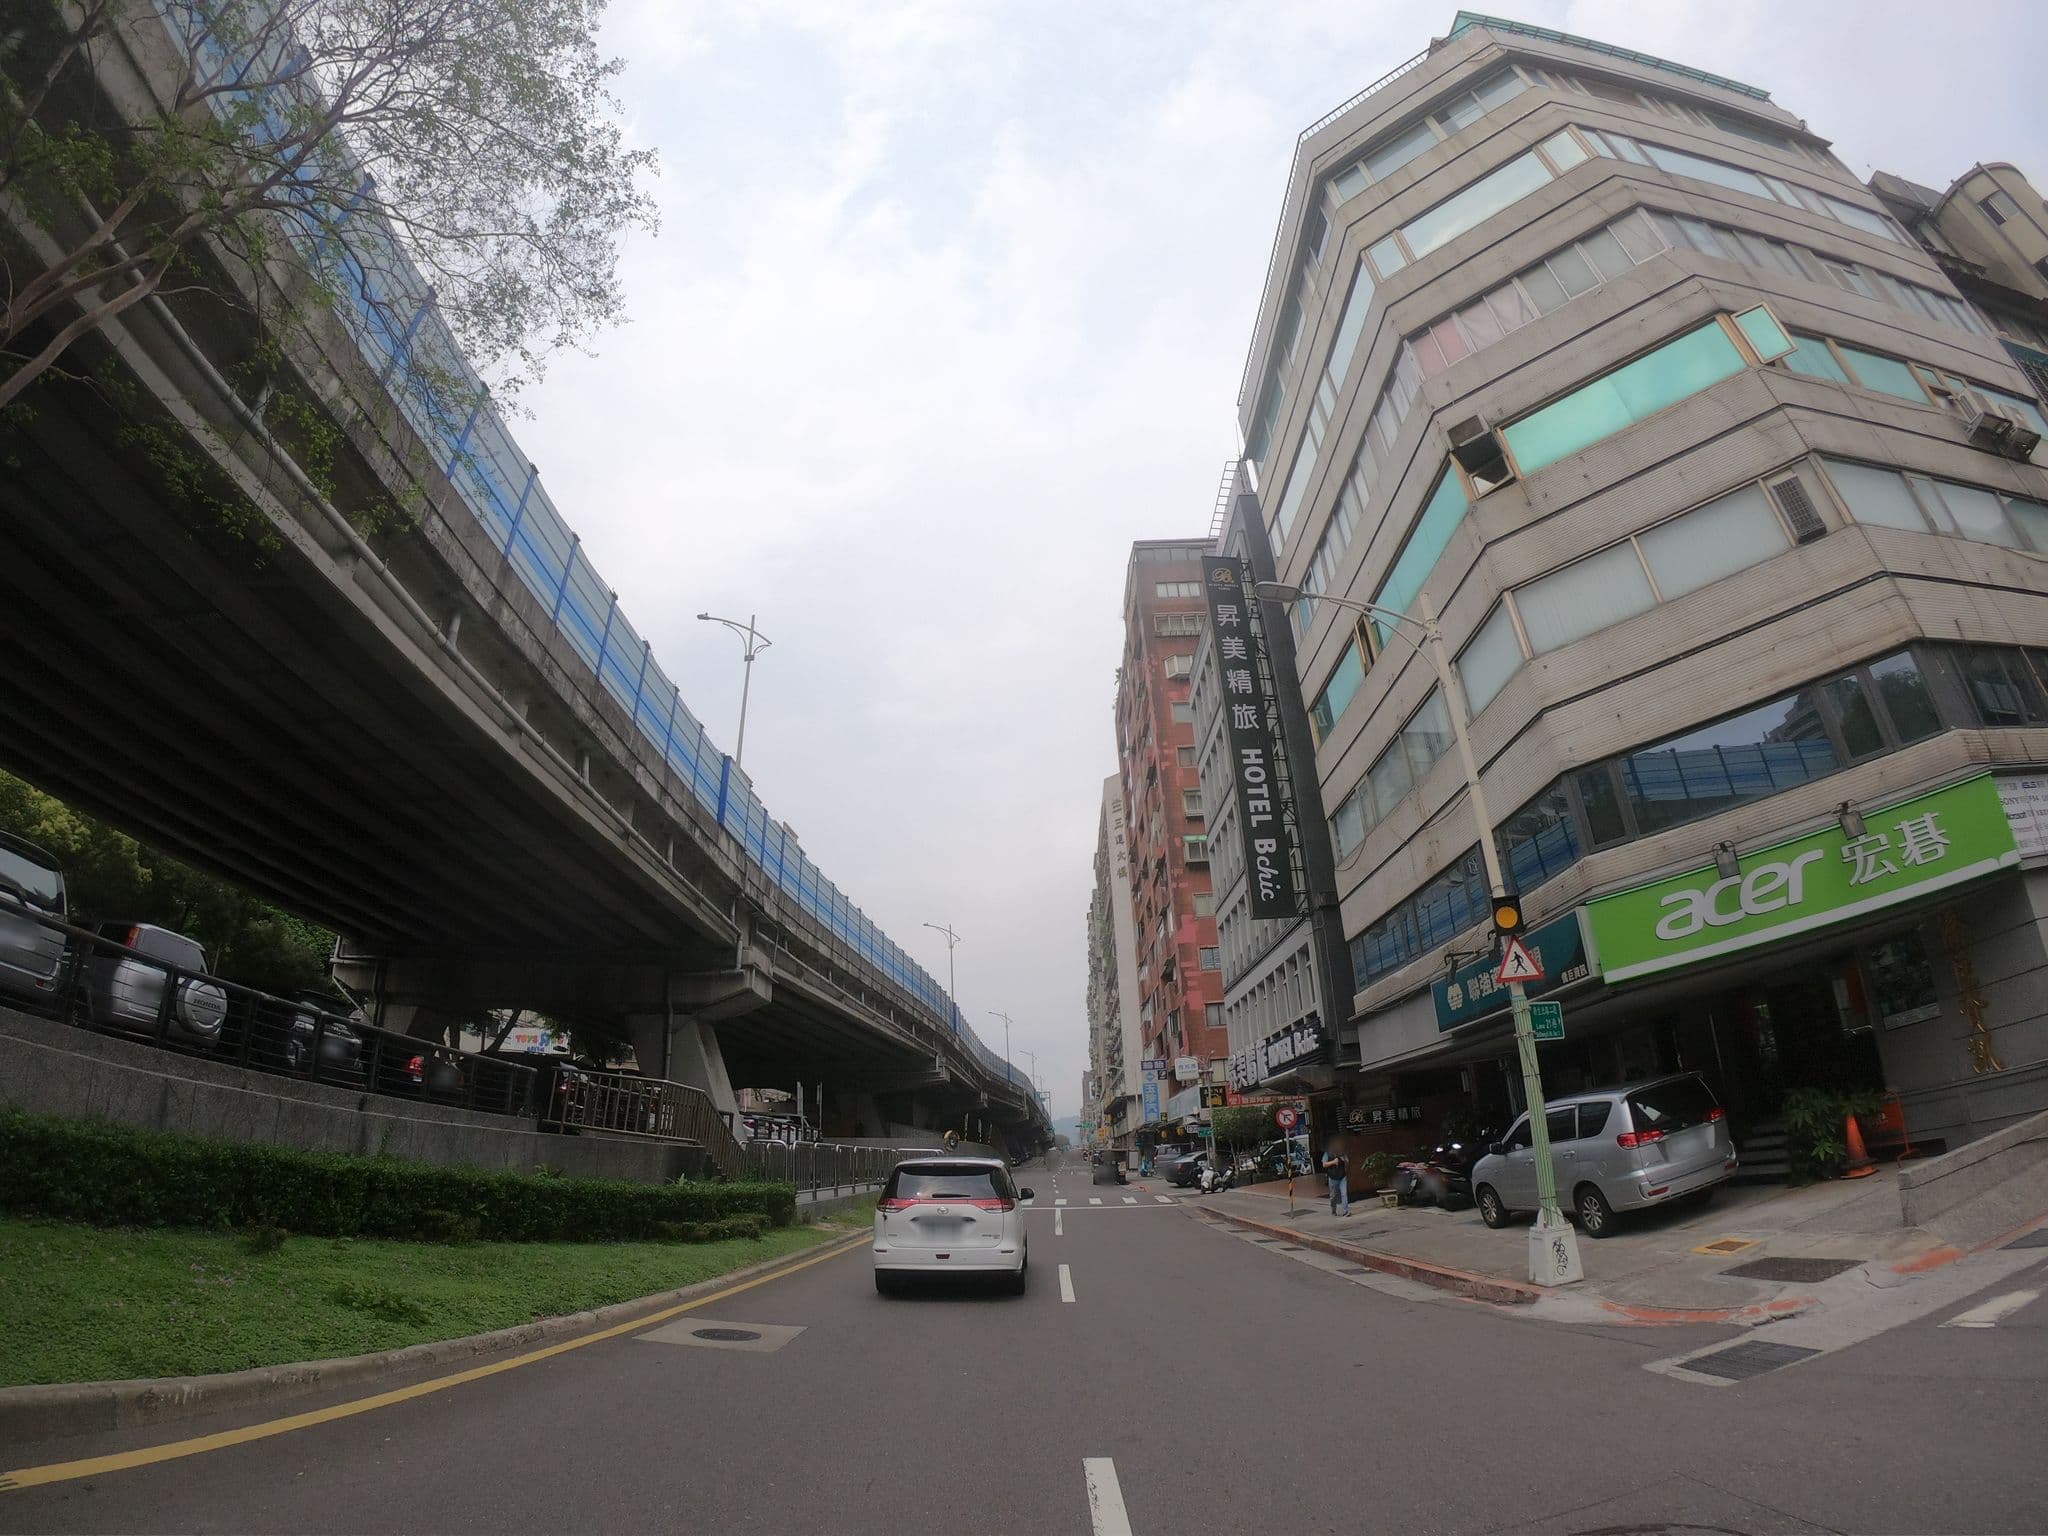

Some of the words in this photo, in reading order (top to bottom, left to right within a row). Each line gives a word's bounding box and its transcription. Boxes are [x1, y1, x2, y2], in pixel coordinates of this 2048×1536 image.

[1216, 604, 1260, 730] 昇美精旅
[1240, 747, 1273, 828] HOTEL
[1840, 812, 1951, 888] 宏碁
[1655, 848, 1824, 941] acer
[193, 998, 222, 1010] HONDA
